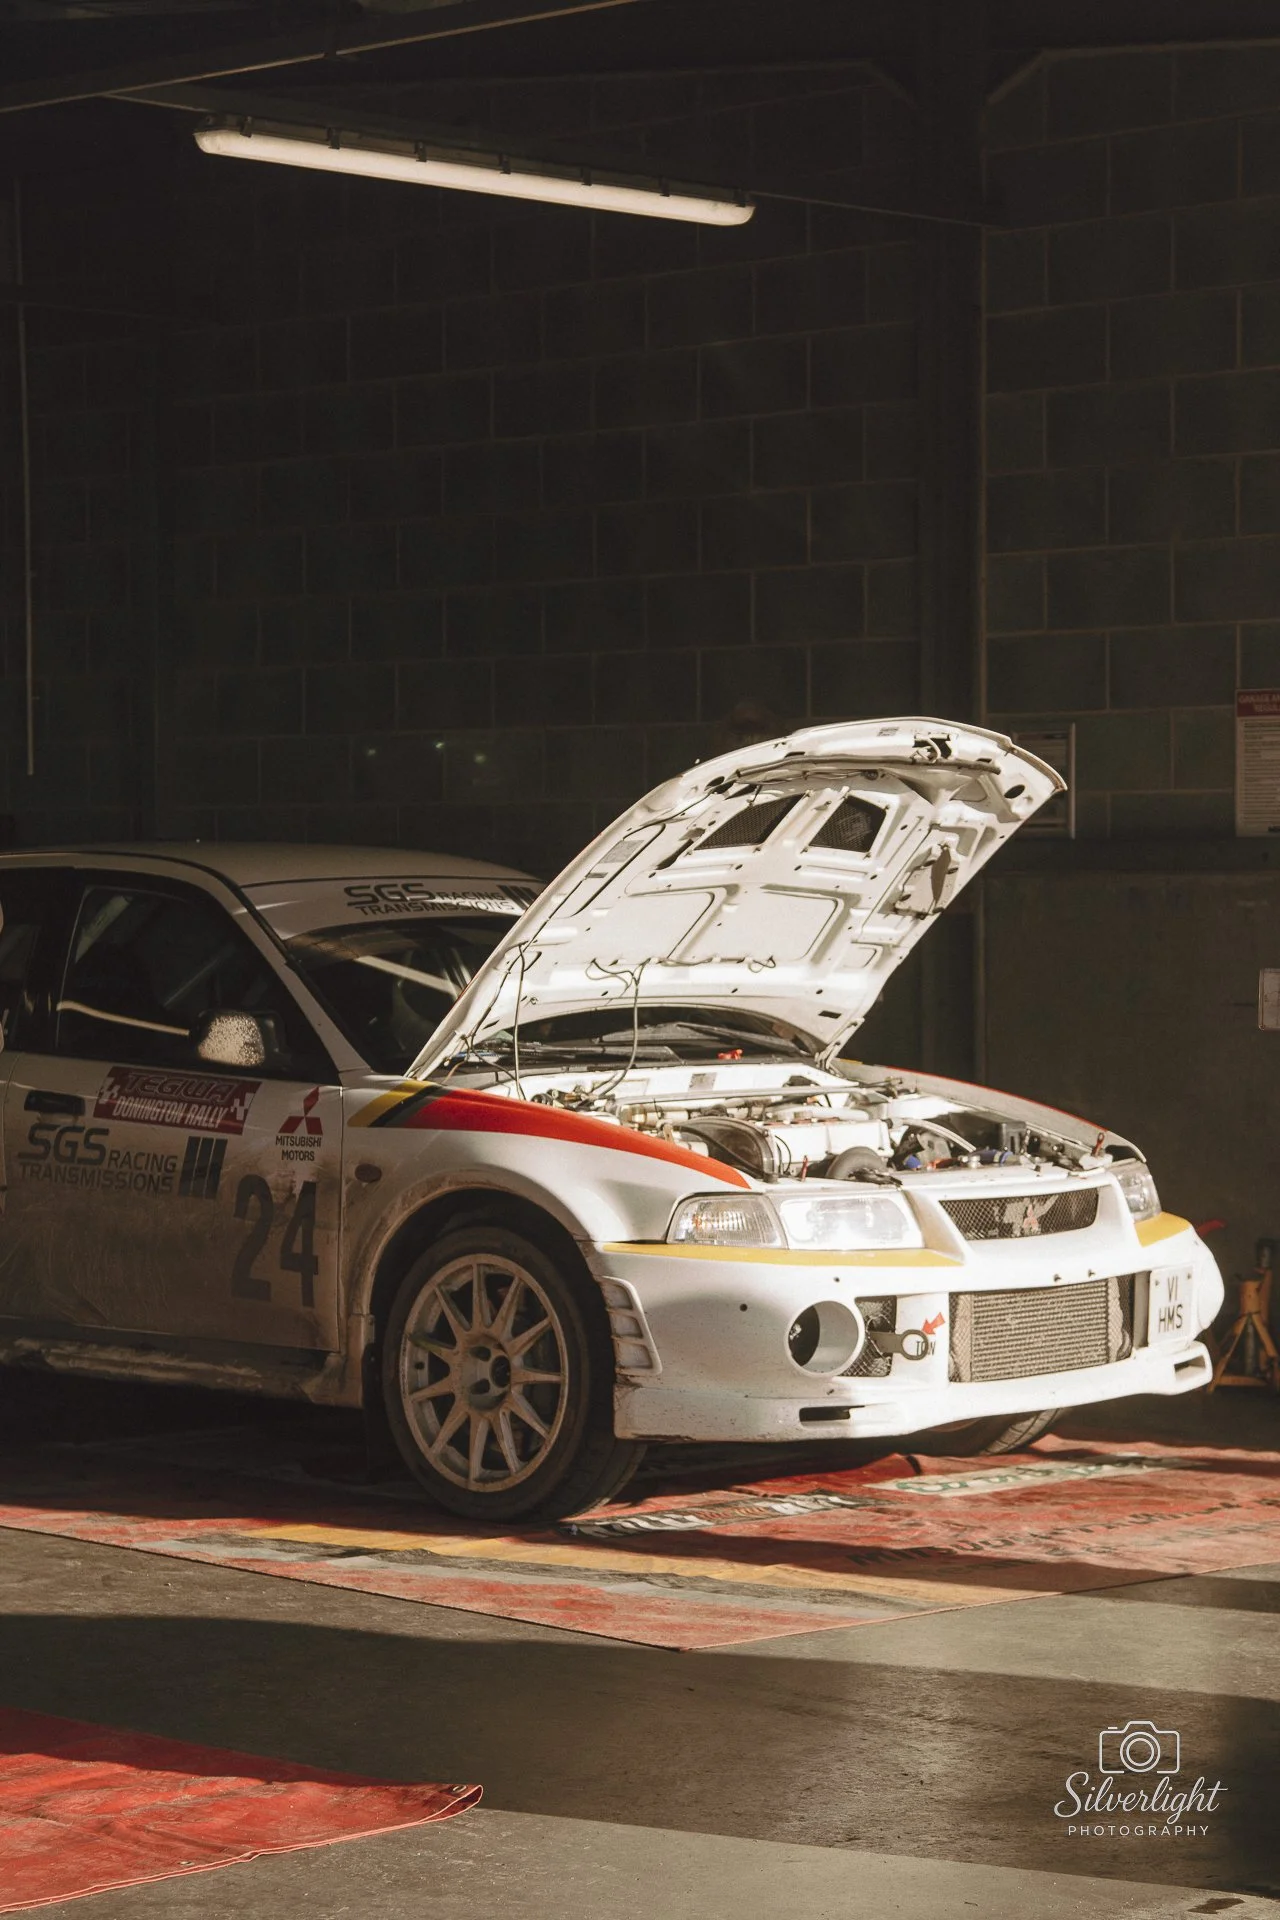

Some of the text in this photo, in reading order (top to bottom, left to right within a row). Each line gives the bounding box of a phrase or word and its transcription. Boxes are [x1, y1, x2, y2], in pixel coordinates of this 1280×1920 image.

[343, 883, 506, 906] SGS RACING
[355, 901, 515, 916] TRANSMISSIONS
[112, 1096, 229, 1128] DONINGTON RALLY
[17, 1123, 178, 1173] SGS RACING
[275, 1135, 322, 1148] MITSUBISHI
[281, 1149, 315, 1162] MOTORS
[19, 1162, 173, 1194] TRANSMISSIONS
[230, 1173, 319, 1308] 24
[1158, 1303, 1184, 1333] HMS
